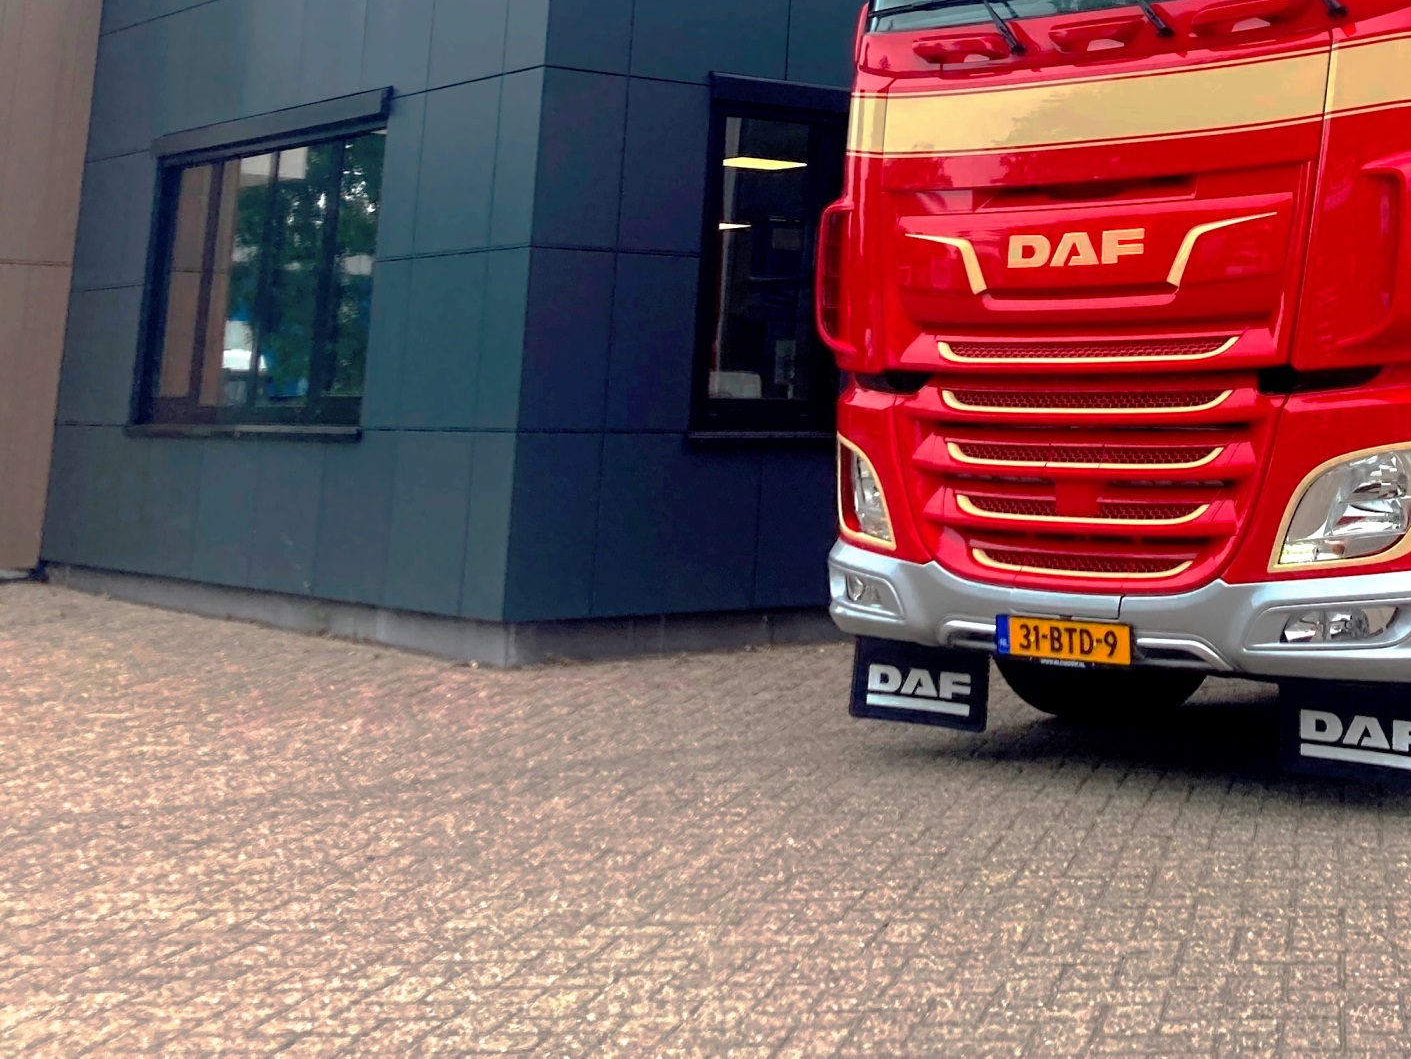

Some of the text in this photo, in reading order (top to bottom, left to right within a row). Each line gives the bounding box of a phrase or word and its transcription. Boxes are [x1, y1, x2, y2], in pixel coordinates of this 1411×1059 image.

[1007, 228, 1145, 269] DAF
[1019, 624, 1118, 657] 31-BTD-9
[867, 663, 971, 700] DAF
